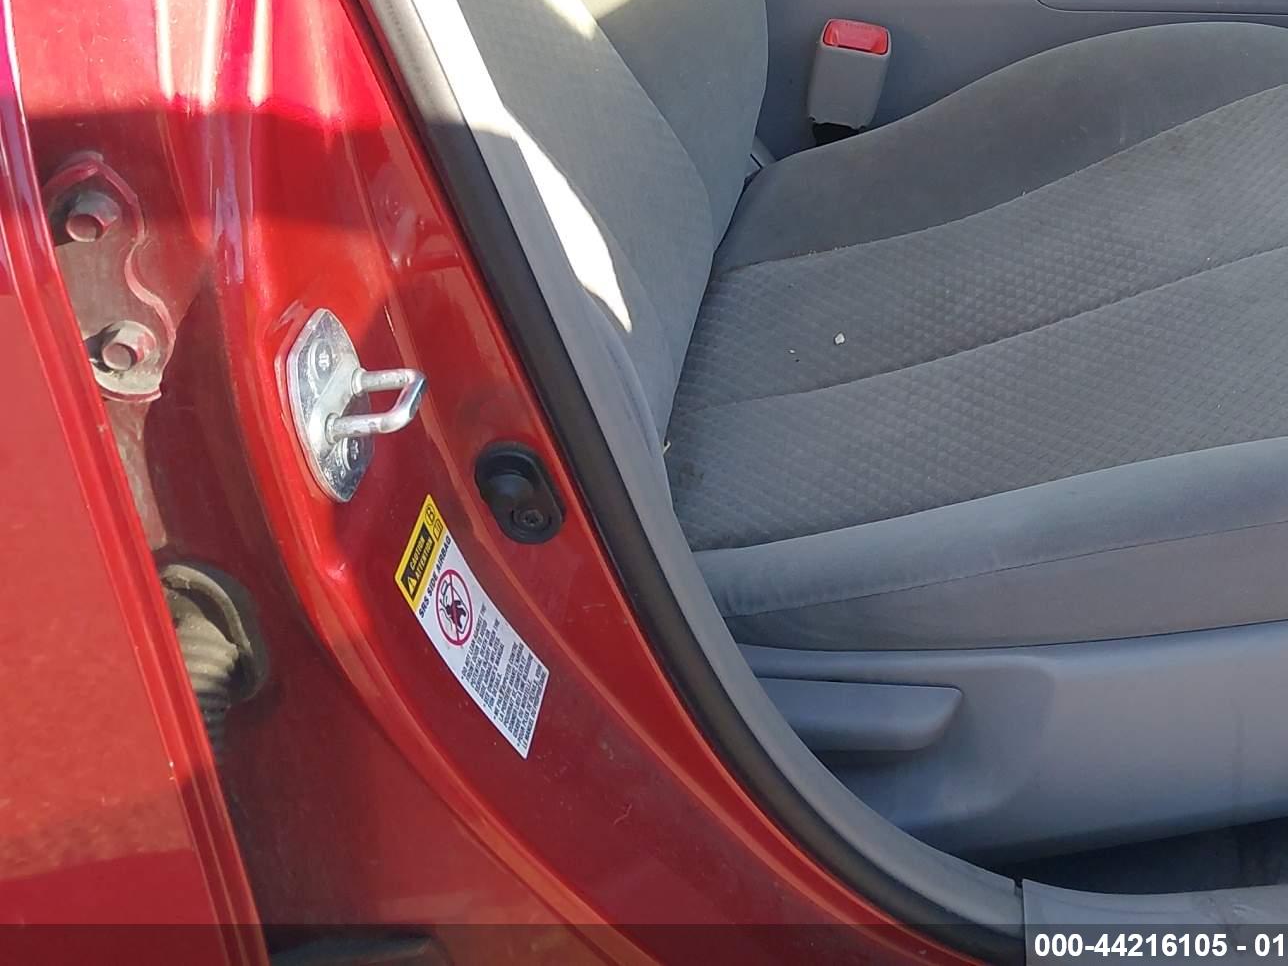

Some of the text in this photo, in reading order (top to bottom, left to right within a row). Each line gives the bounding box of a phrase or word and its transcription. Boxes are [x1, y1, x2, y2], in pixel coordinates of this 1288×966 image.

[410, 536, 426, 570] CAUTION
[414, 539, 434, 580] ATTENTION
[418, 536, 452, 618] SRS SIDE AIRBAG
